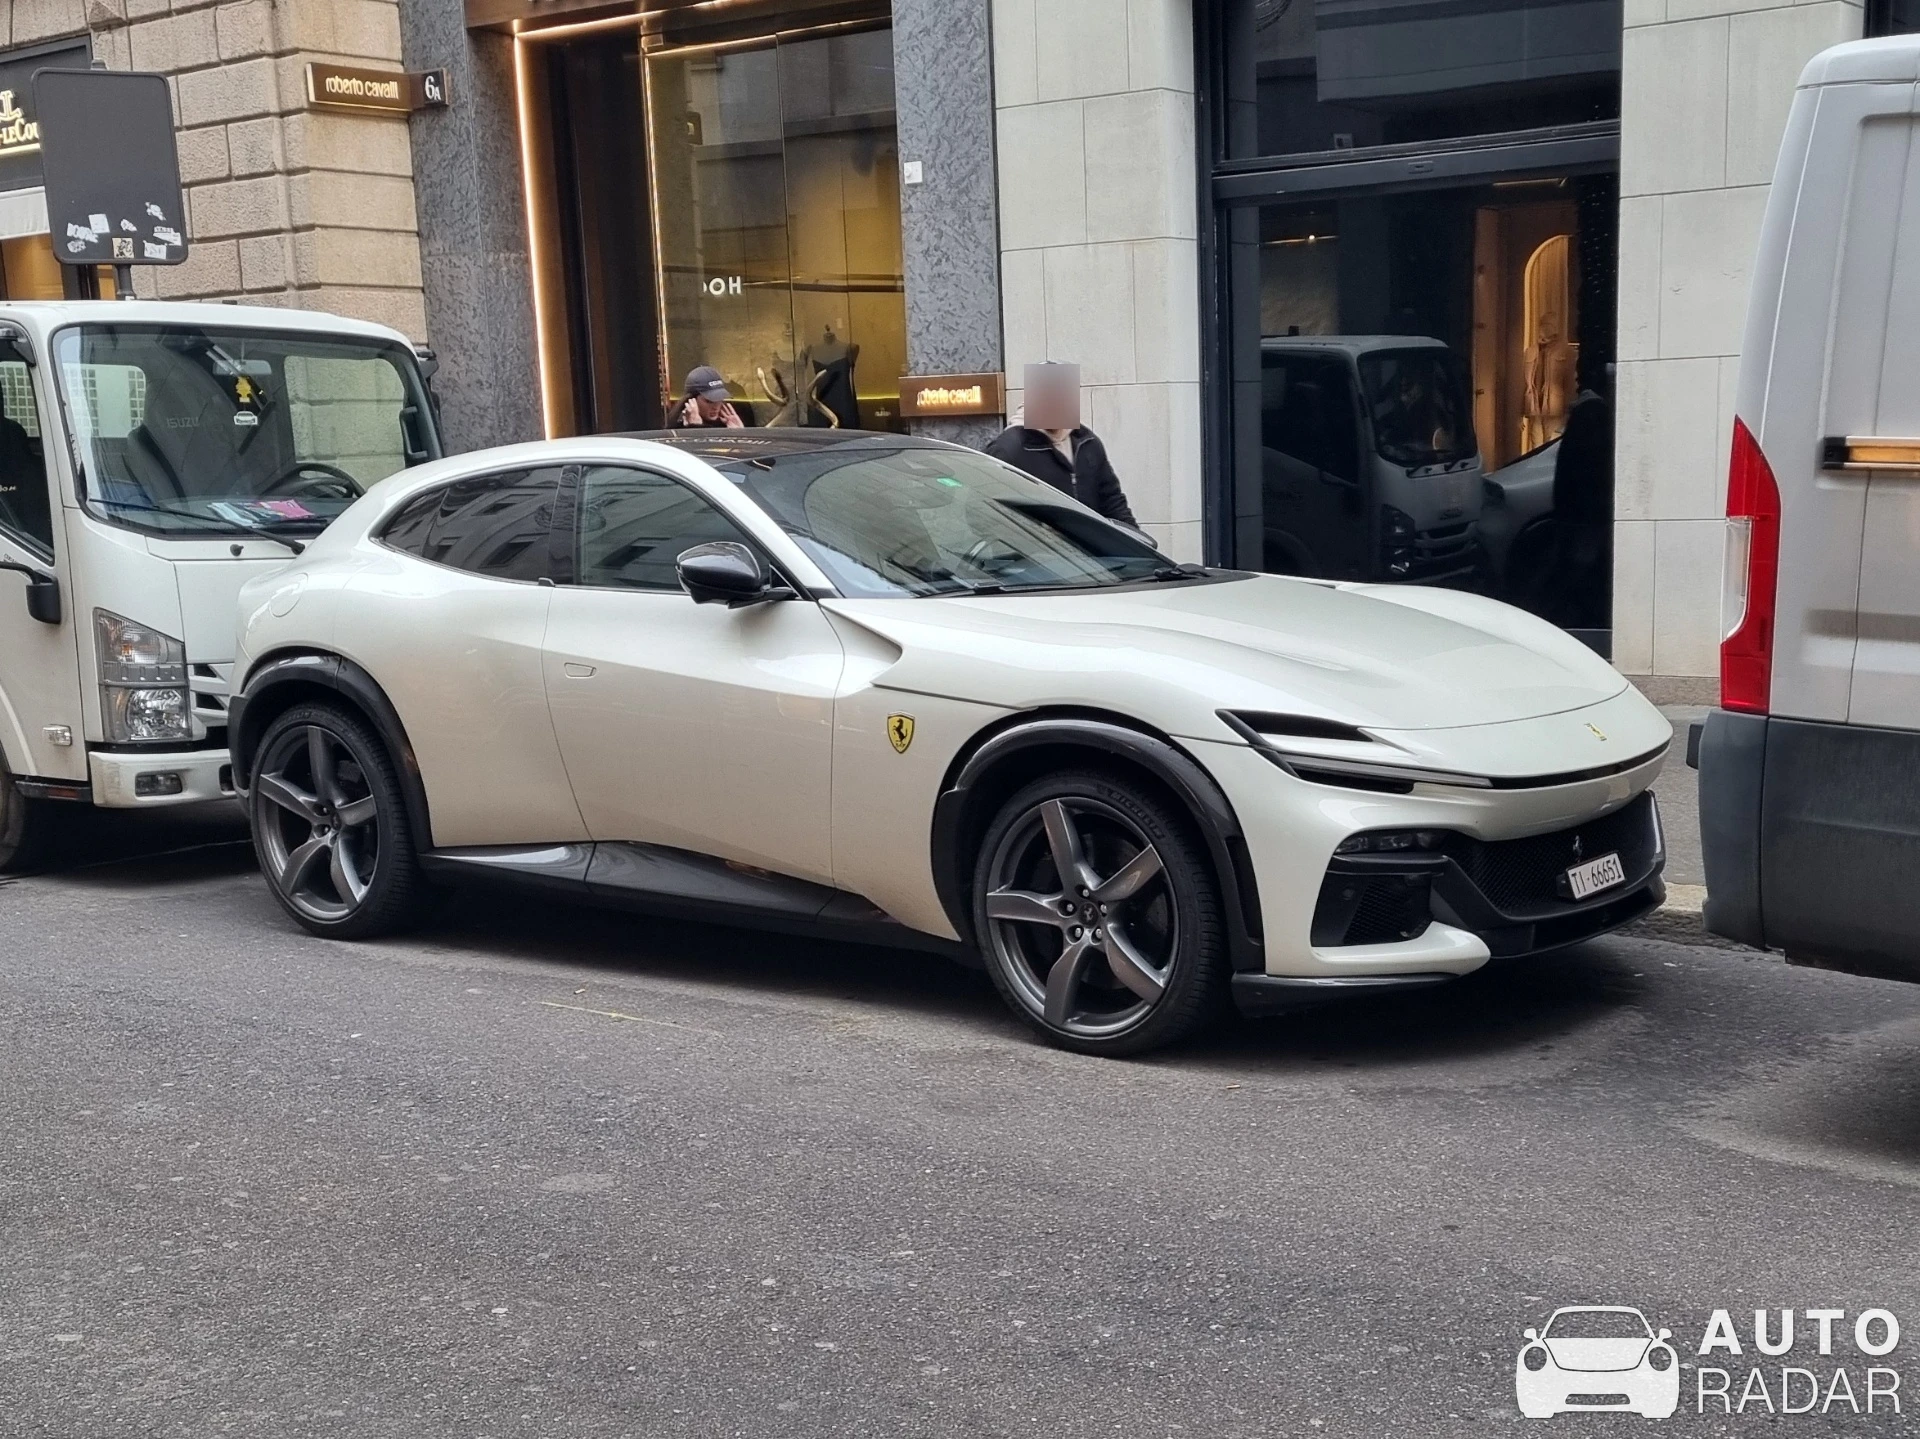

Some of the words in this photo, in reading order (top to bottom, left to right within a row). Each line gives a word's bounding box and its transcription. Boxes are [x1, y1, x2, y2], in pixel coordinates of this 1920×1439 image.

[325, 75, 364, 96] roberto
[364, 80, 399, 99] cavalli
[424, 75, 442, 101] 6A
[166, 416, 200, 429] ISUZU
